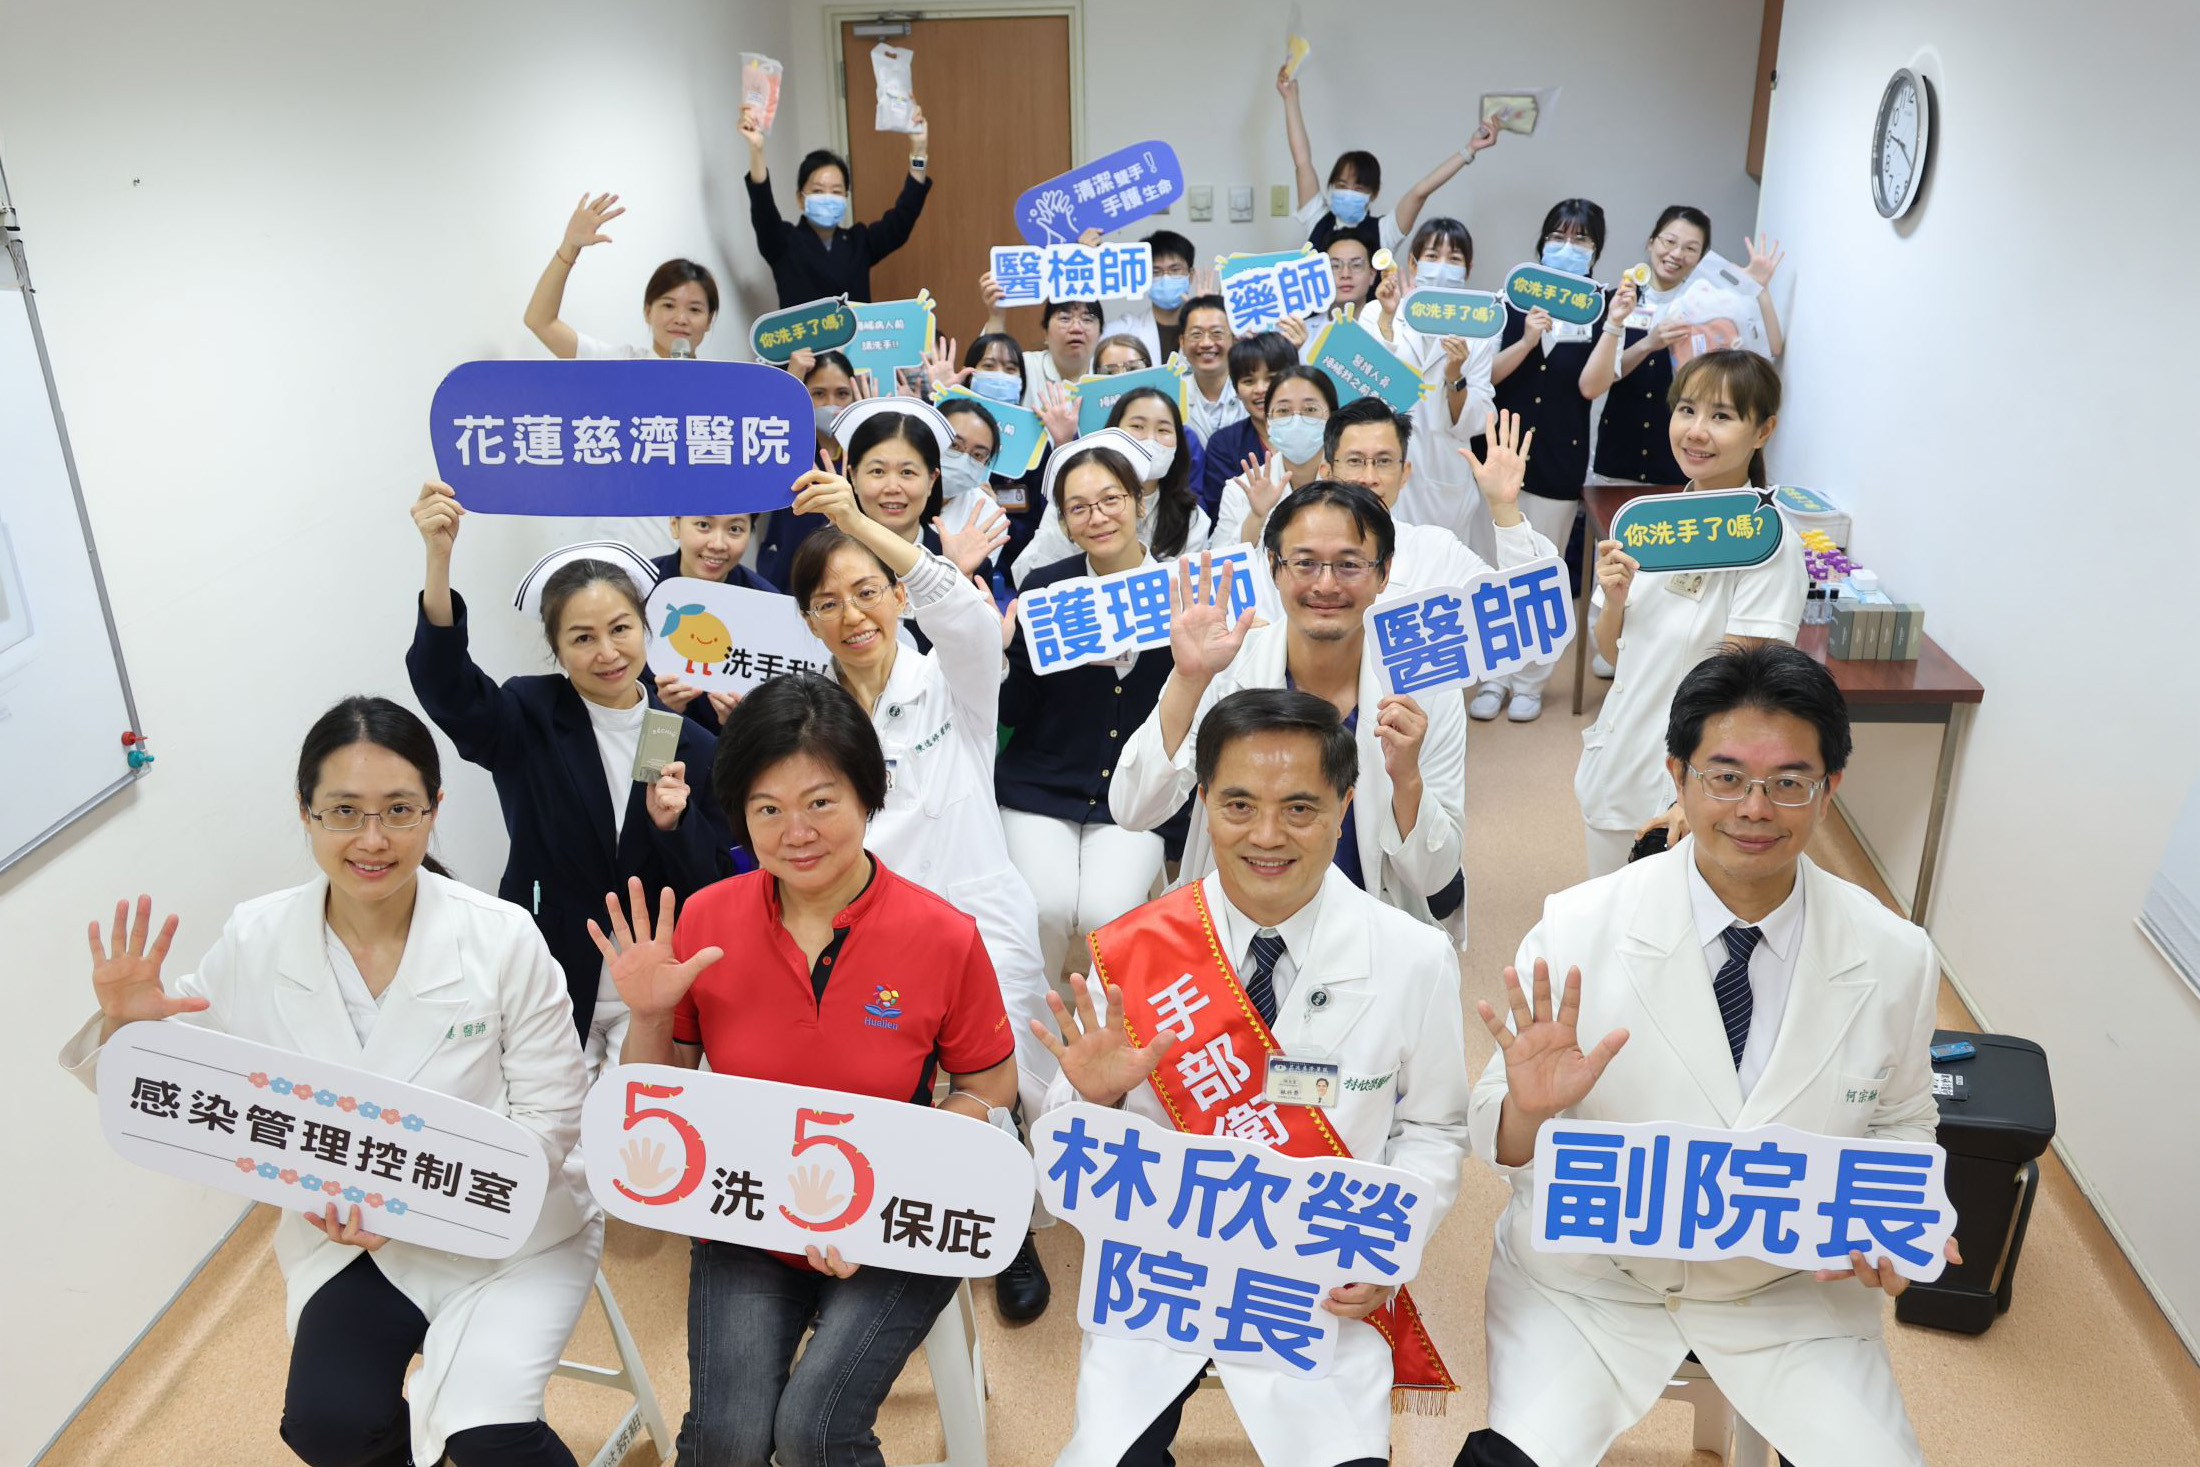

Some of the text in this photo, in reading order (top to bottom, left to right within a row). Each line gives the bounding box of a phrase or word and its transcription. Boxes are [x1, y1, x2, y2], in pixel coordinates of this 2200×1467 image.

[1884, 154, 1890, 173] 8
[1888, 174, 1894, 192] 7
[1101, 178, 1172, 218] 手護生命
[1894, 185, 1900, 204] 6
[995, 247, 1147, 300] 醫檢師
[1226, 258, 1331, 329] 藥師
[1513, 277, 1594, 310] 你洗手了嗎?
[759, 313, 845, 348] 你洗手了嗎?
[1410, 301, 1496, 323] 你洗手了嗎?
[453, 414, 792, 466] 花蓮慈濟醫院
[1623, 514, 1764, 548] 你洗手了嗎?
[1373, 565, 1567, 694] 醫師
[864, 1016, 898, 1031] Hualien
[129, 1076, 518, 1214] 感染管理控制室
[1047, 1117, 1418, 1276] 林欣榮
[1544, 1131, 1941, 1267] 副院長
[1093, 1239, 1325, 1372] 院長
